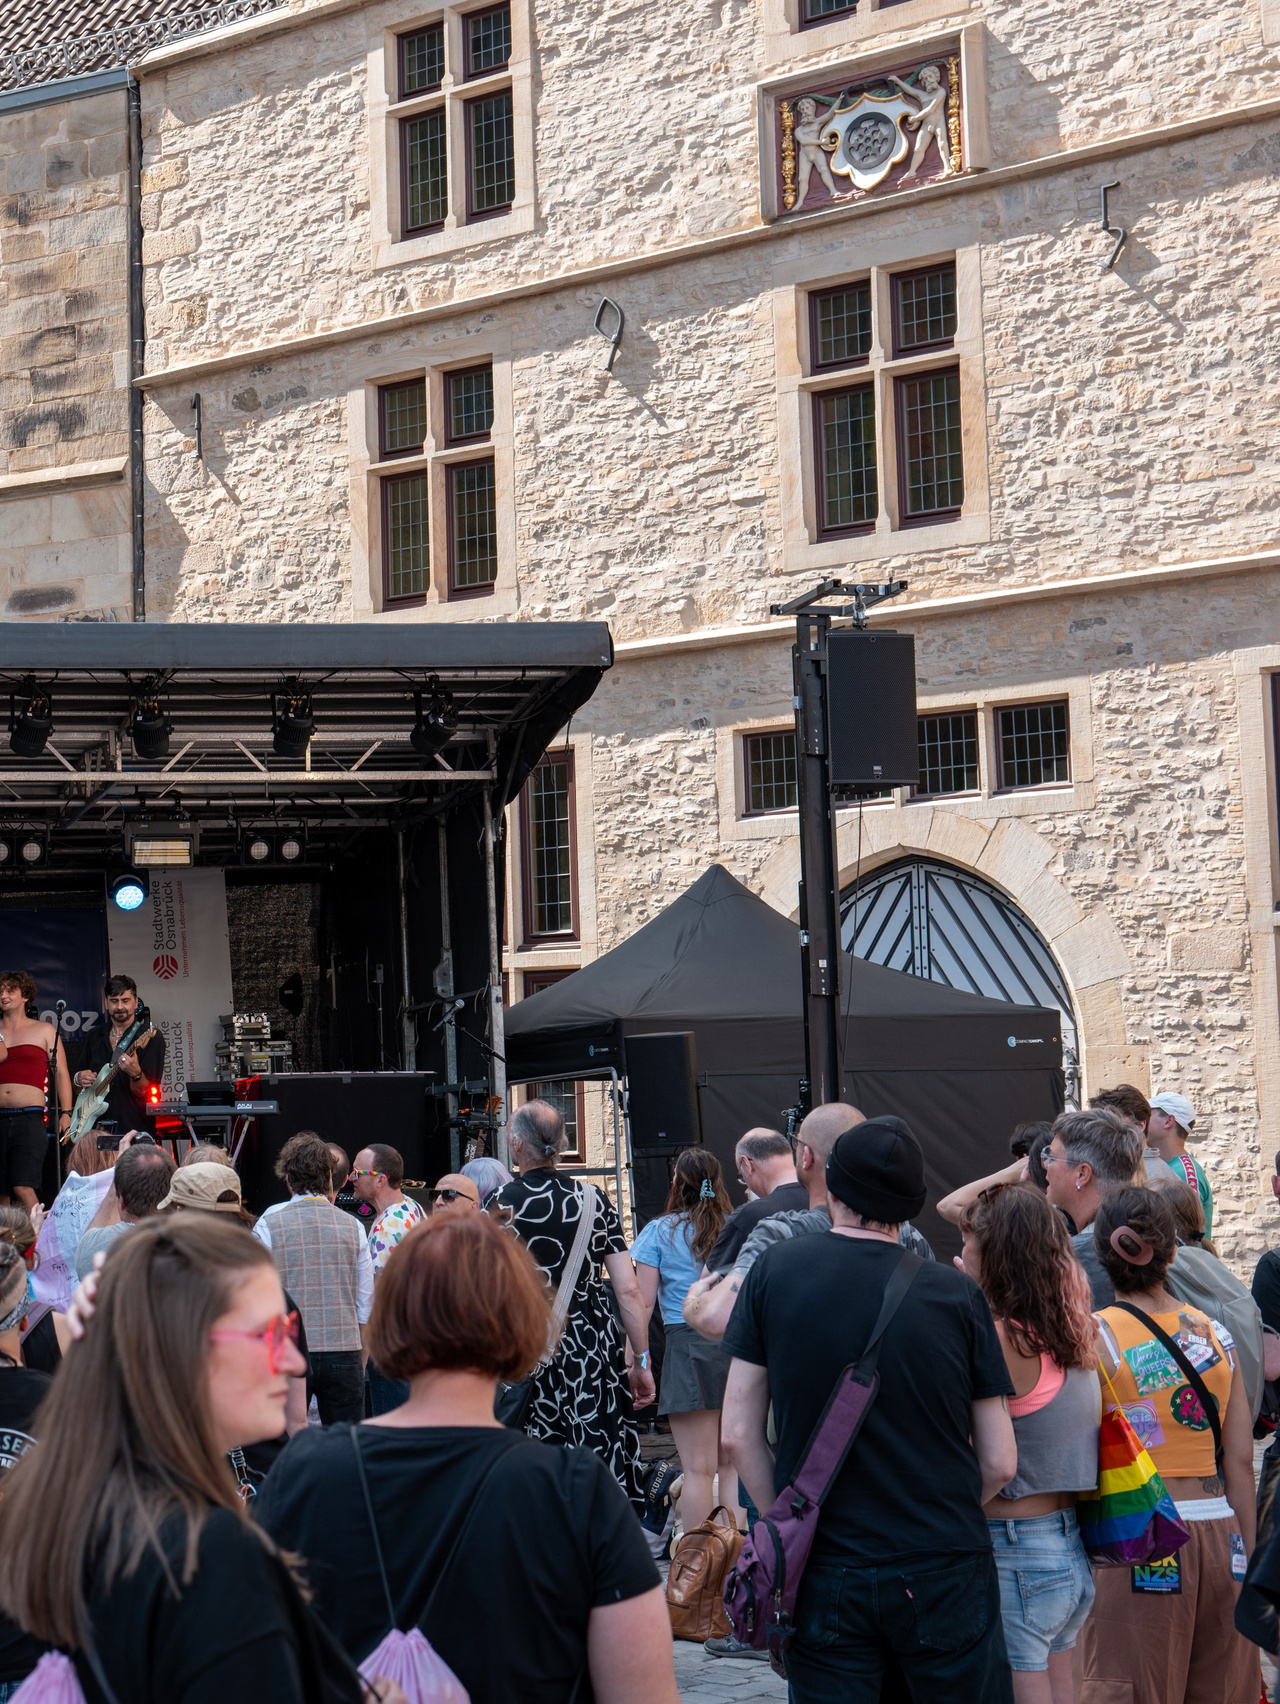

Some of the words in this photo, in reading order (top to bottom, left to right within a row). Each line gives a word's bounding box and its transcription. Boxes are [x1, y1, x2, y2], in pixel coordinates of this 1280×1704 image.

[150, 880, 165, 950] Stadtwerke
[161, 880, 177, 950] Osnabrück
[176, 880, 187, 930] Lebensqualität
[180, 930, 190, 978] Unternehmen
[40, 1009, 99, 1032] noz
[171, 1021, 184, 1093] Osnabrück
[1134, 1565, 1179, 1583] NZS
